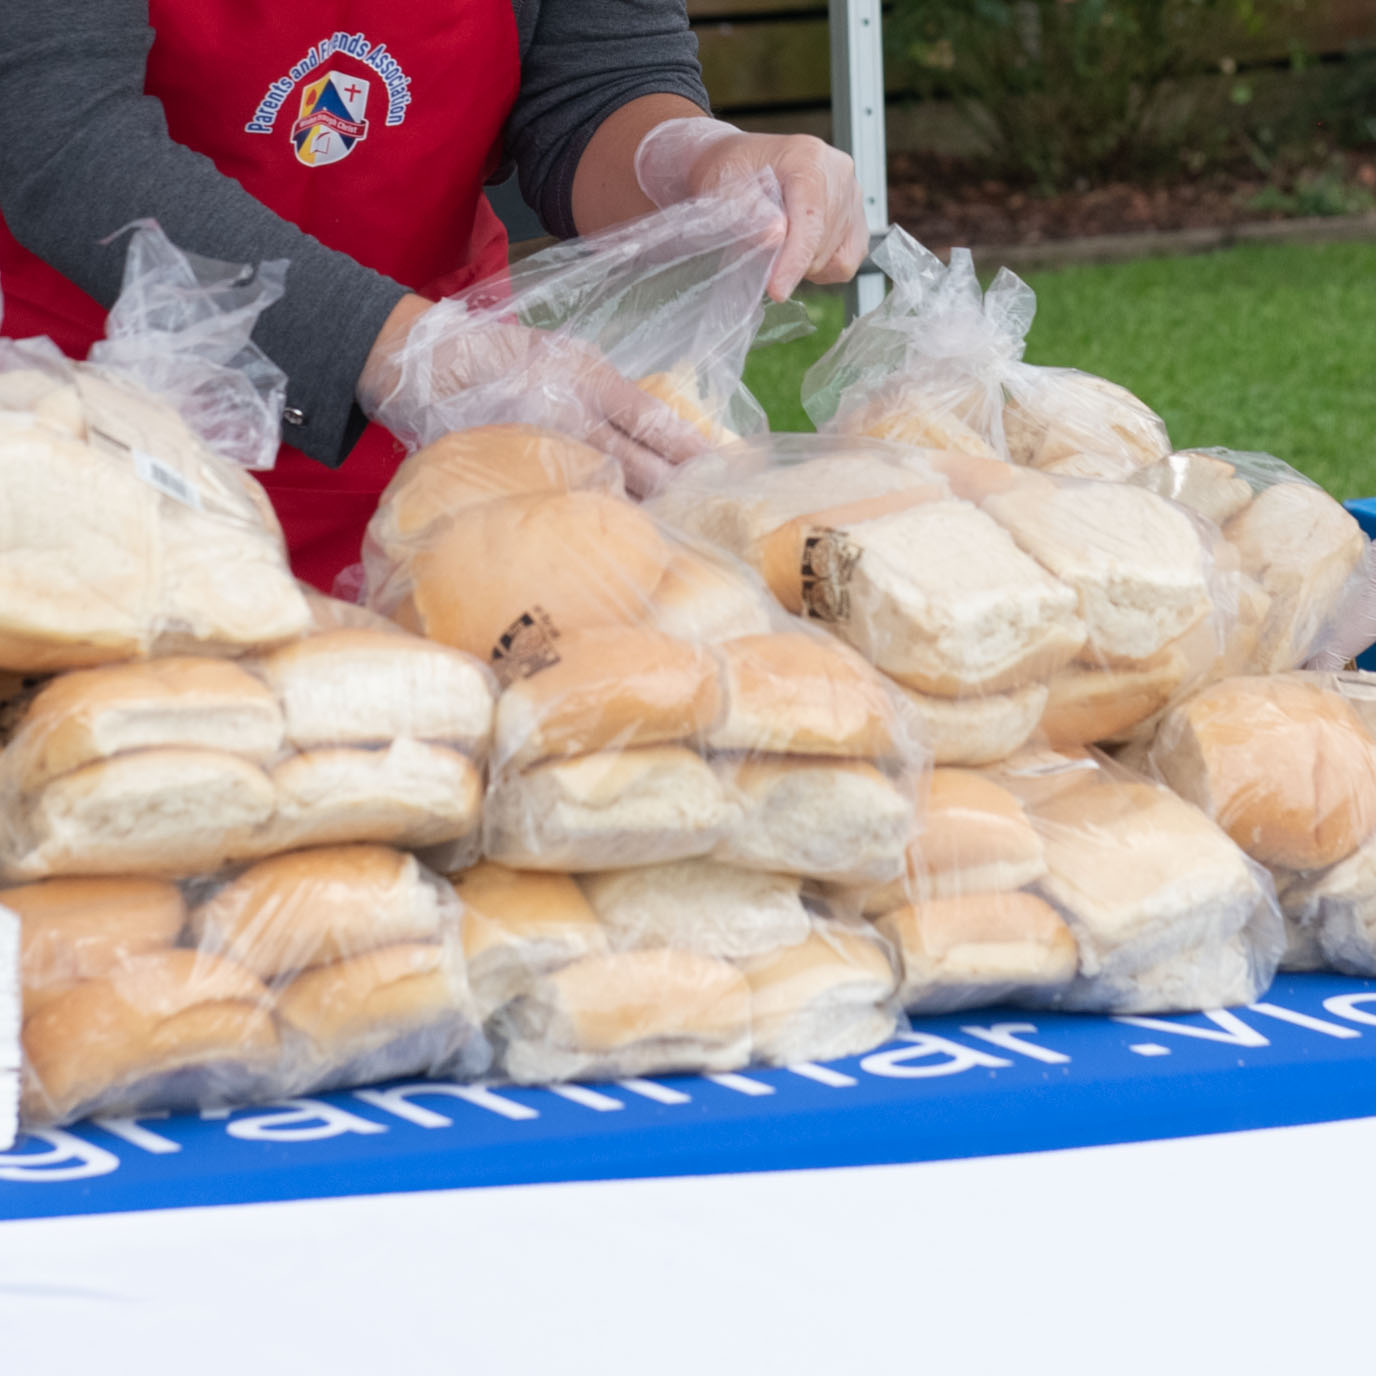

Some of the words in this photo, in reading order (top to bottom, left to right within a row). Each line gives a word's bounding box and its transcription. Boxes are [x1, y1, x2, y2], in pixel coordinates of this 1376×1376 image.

[246, 77, 294, 133] Parents
[290, 48, 319, 81] and
[366, 45, 411, 125] Association
